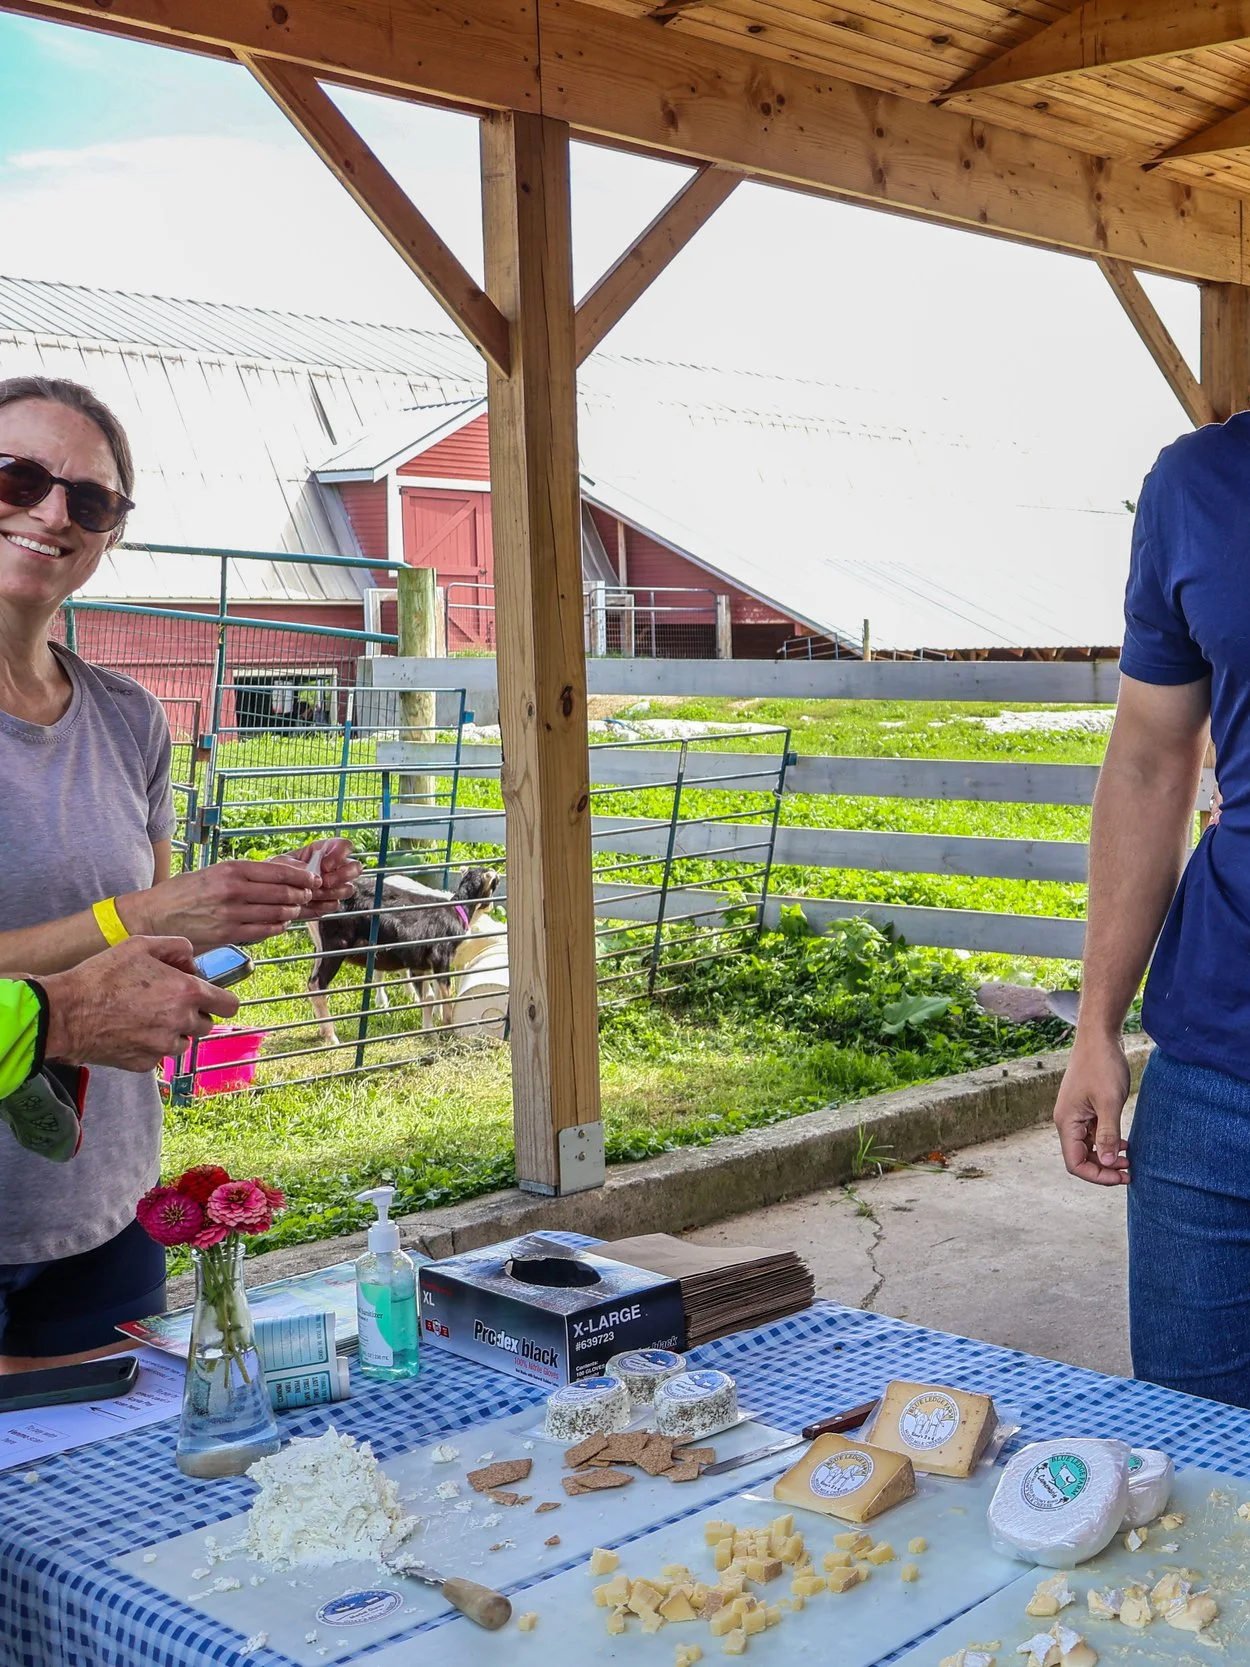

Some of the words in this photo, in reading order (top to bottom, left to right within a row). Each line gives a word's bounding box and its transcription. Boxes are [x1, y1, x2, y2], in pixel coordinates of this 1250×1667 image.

[422, 1289, 436, 1307] XL
[573, 1304, 641, 1338] X-LARGE
[472, 1318, 520, 1355] Prodex
[521, 1337, 560, 1369] black
[575, 1331, 615, 1352] #639723
[1051, 1455, 1071, 1463] BLUE
[1070, 1458, 1086, 1477] LEDGE
[1037, 1474, 1057, 1499] Camembrie
[1070, 1477, 1086, 1496] FARM
